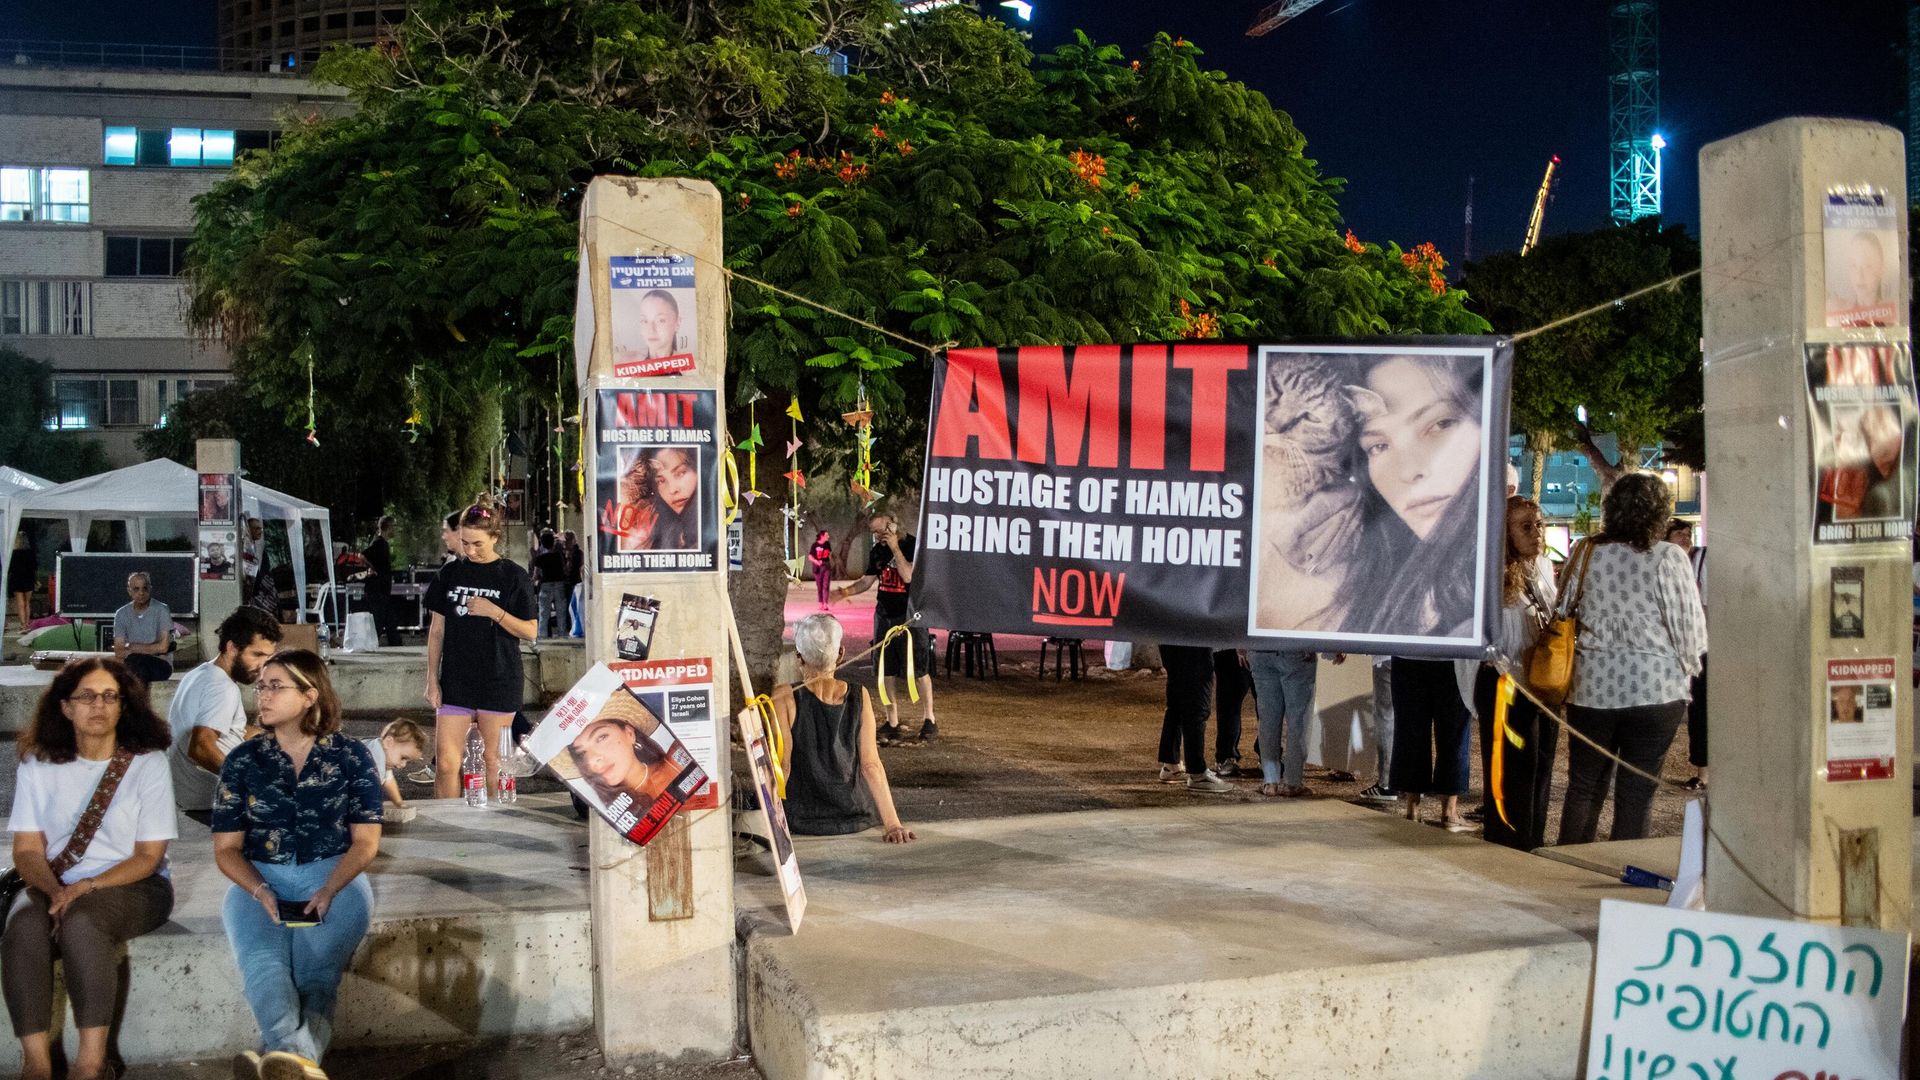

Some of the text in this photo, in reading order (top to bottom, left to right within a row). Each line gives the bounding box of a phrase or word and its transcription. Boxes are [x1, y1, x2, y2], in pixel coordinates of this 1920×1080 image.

[611, 264, 695, 279] אגם גולדשטיין
[636, 278, 672, 288] הביתה
[617, 357, 690, 377] KIDNAPPED!
[615, 392, 698, 428] AMIT
[931, 343, 1249, 473] AMIT
[602, 429, 712, 443] HOSTAGE OF HAMAS
[929, 467, 1244, 519] HOSTAGE OF HAMAS
[926, 513, 1242, 568] BRING THEM HOME
[1819, 521, 1913, 540] BRING THEM HOME
[603, 553, 713, 569] BRING THEM HOME
[454, 586, 501, 599] אחרת
[1032, 567, 1126, 617] NOW
[1831, 664, 1892, 676] KIDNAPPED
[558, 697, 589, 731] SHANI GABAY
[605, 791, 633, 823] BRING
[650, 790, 678, 821] NOW!
[615, 811, 638, 834] HER
[1633, 926, 1884, 998] החזרת
[1613, 978, 1831, 1050] החטופים
